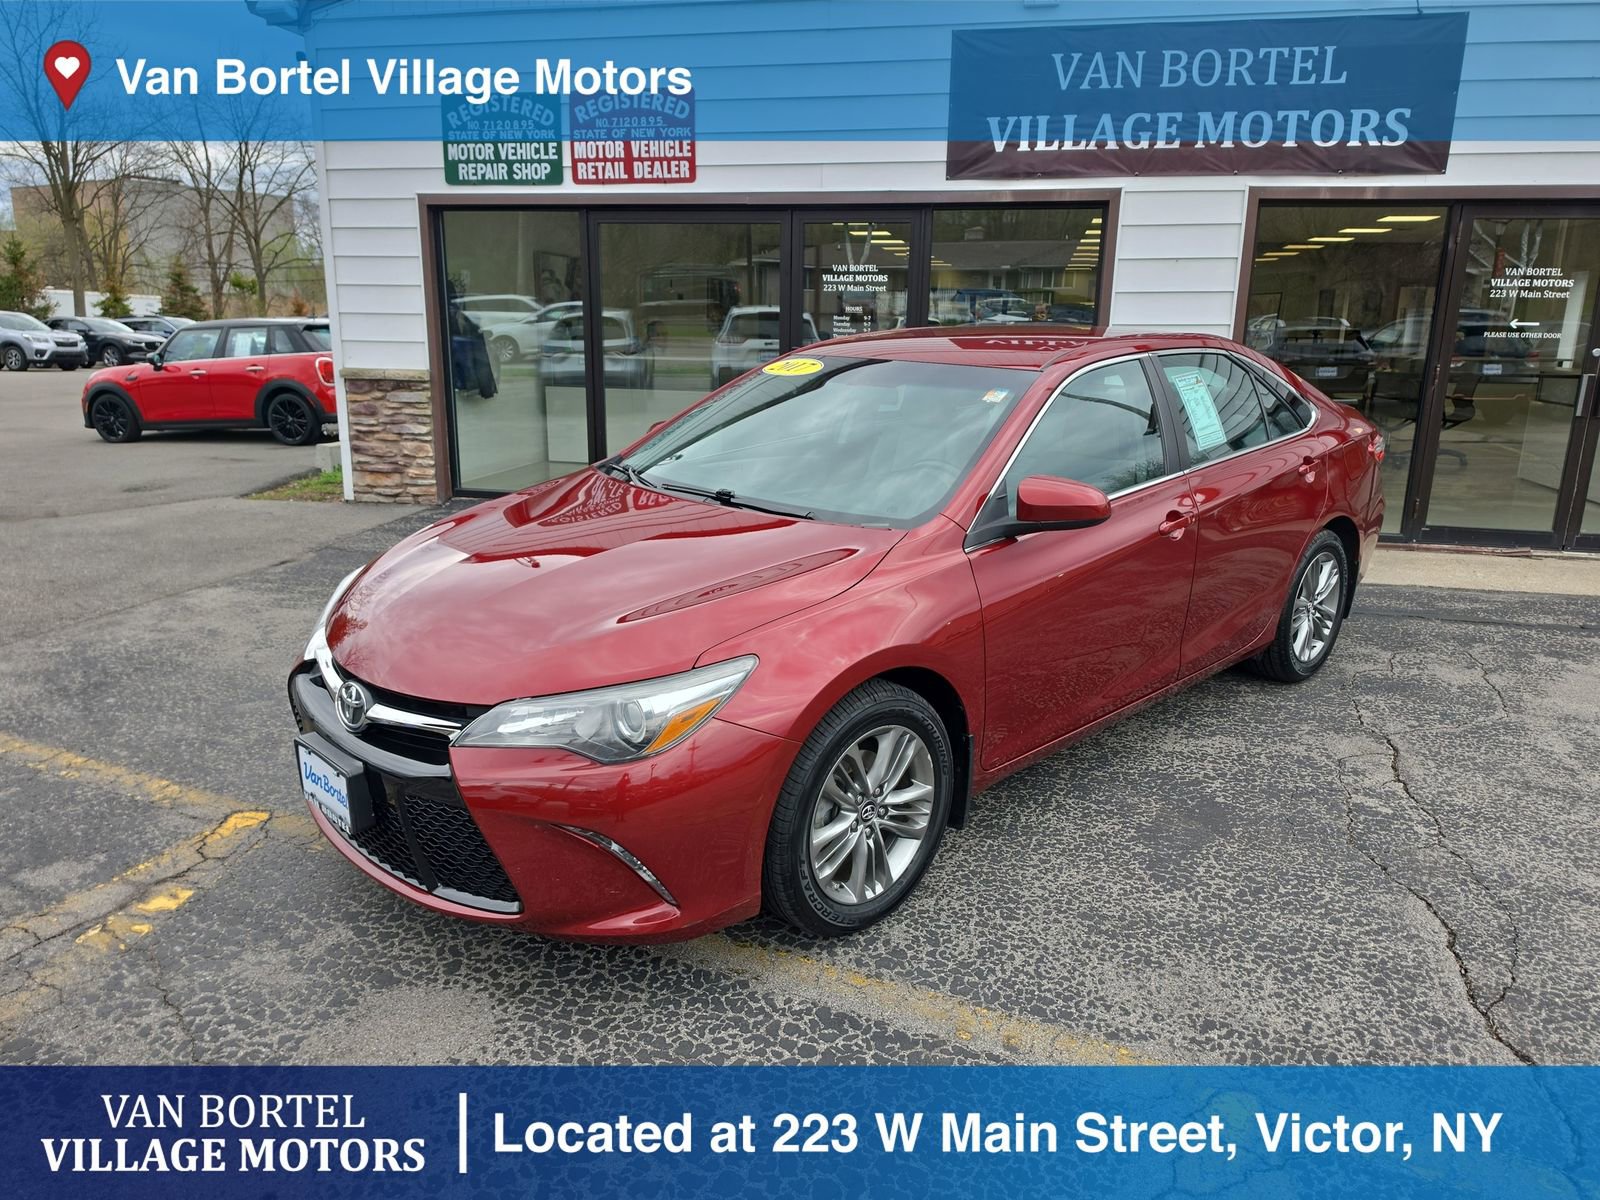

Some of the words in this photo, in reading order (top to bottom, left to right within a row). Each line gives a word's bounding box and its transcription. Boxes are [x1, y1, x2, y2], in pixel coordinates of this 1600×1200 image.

[1051, 50, 1146, 90] VAN
[1159, 46, 1347, 88] BORTEL
[447, 95, 555, 129] REGISTERED
[574, 94, 690, 124] REGISTERED
[483, 120, 535, 130] 7120895
[612, 117, 664, 128] 7120895
[448, 131, 480, 140] STATE
[482, 131, 496, 140] OF
[499, 131, 524, 140] NEW
[526, 130, 556, 140] YORK
[573, 129, 608, 139] STATE
[611, 129, 628, 139] OF
[630, 128, 656, 138] NEW
[659, 127, 692, 138] YORK
[987, 111, 1183, 153] VILLAGE
[1194, 108, 1412, 149] MOTORS
[448, 143, 495, 161] MOTOR
[497, 143, 558, 160] VEHICLE
[574, 141, 625, 159] MOTOR
[630, 140, 692, 158] VEHICLE
[458, 163, 508, 181] REPAIR
[512, 163, 551, 180] SHOP
[577, 162, 628, 180] RETAIL
[633, 161, 690, 179] DEALER
[832, 264, 848, 272] VAN
[849, 264, 879, 272] BORTEL
[1505, 267, 1524, 276] VAN
[1526, 267, 1563, 276] BORTEL
[822, 274, 854, 282] VILLAGE
[855, 274, 889, 282] MOTORS
[1490, 278, 1531, 287] VILLAGE
[1532, 278, 1575, 288] MOTORS
[823, 284, 837, 292] 223
[838, 284, 846, 292] W
[847, 284, 865, 292] Main
[866, 284, 887, 292] Street
[1489, 289, 1507, 298] 223
[1508, 289, 1519, 298] W
[1520, 290, 1541, 298] Main
[1543, 290, 1571, 299] Street
